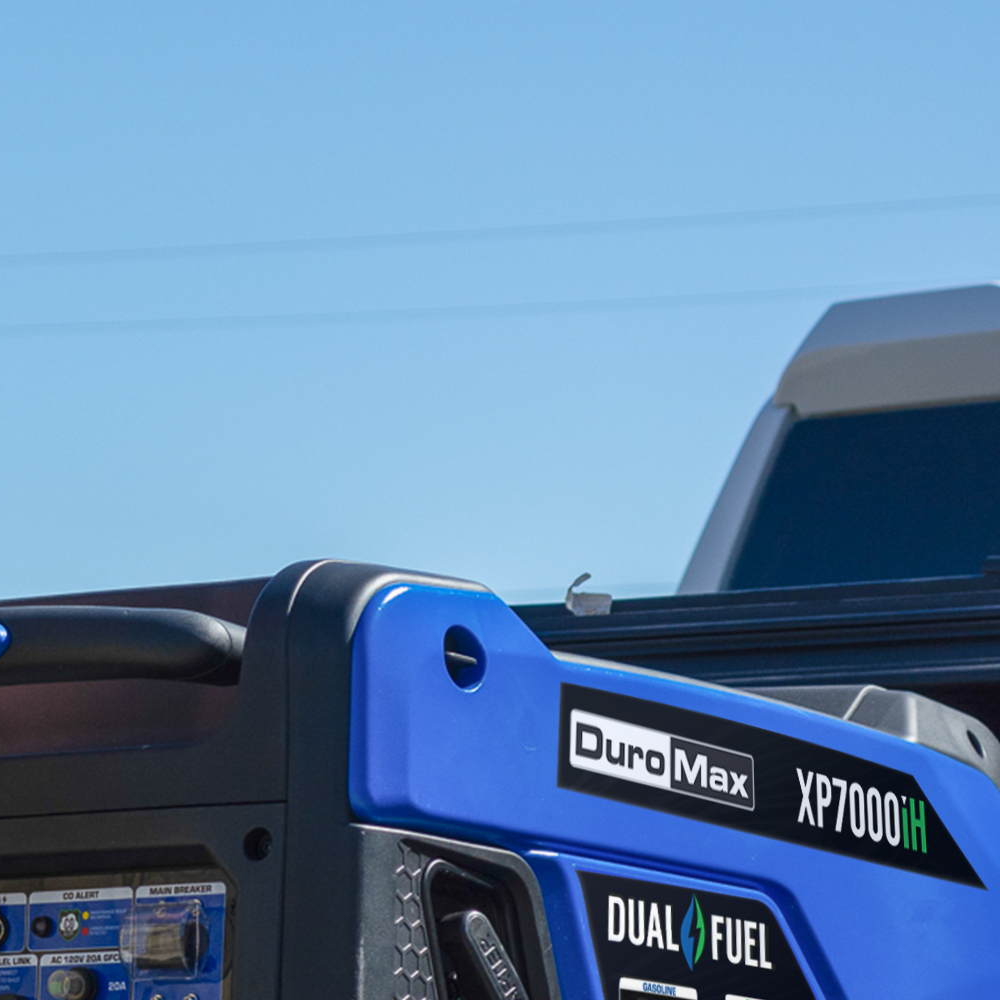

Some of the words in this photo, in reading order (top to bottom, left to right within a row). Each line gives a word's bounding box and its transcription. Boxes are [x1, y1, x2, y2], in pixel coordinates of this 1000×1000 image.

[575, 721, 750, 799] DuroMax
[796, 767, 928, 854] XP7000iH
[63, 891, 74, 900] CO
[76, 890, 99, 900] ALERT
[149, 886, 173, 895] MAIN
[174, 884, 212, 894] BREAKER
[608, 895, 680, 952] DUAL
[711, 914, 773, 970] FUEL
[13, 956, 31, 965] LINK
[51, 955, 63, 964] AC
[64, 954, 85, 963] 120V
[86, 953, 102, 962] 20A
[108, 981, 127, 991] 20A
[642, 982, 676, 997] GASOLINE
